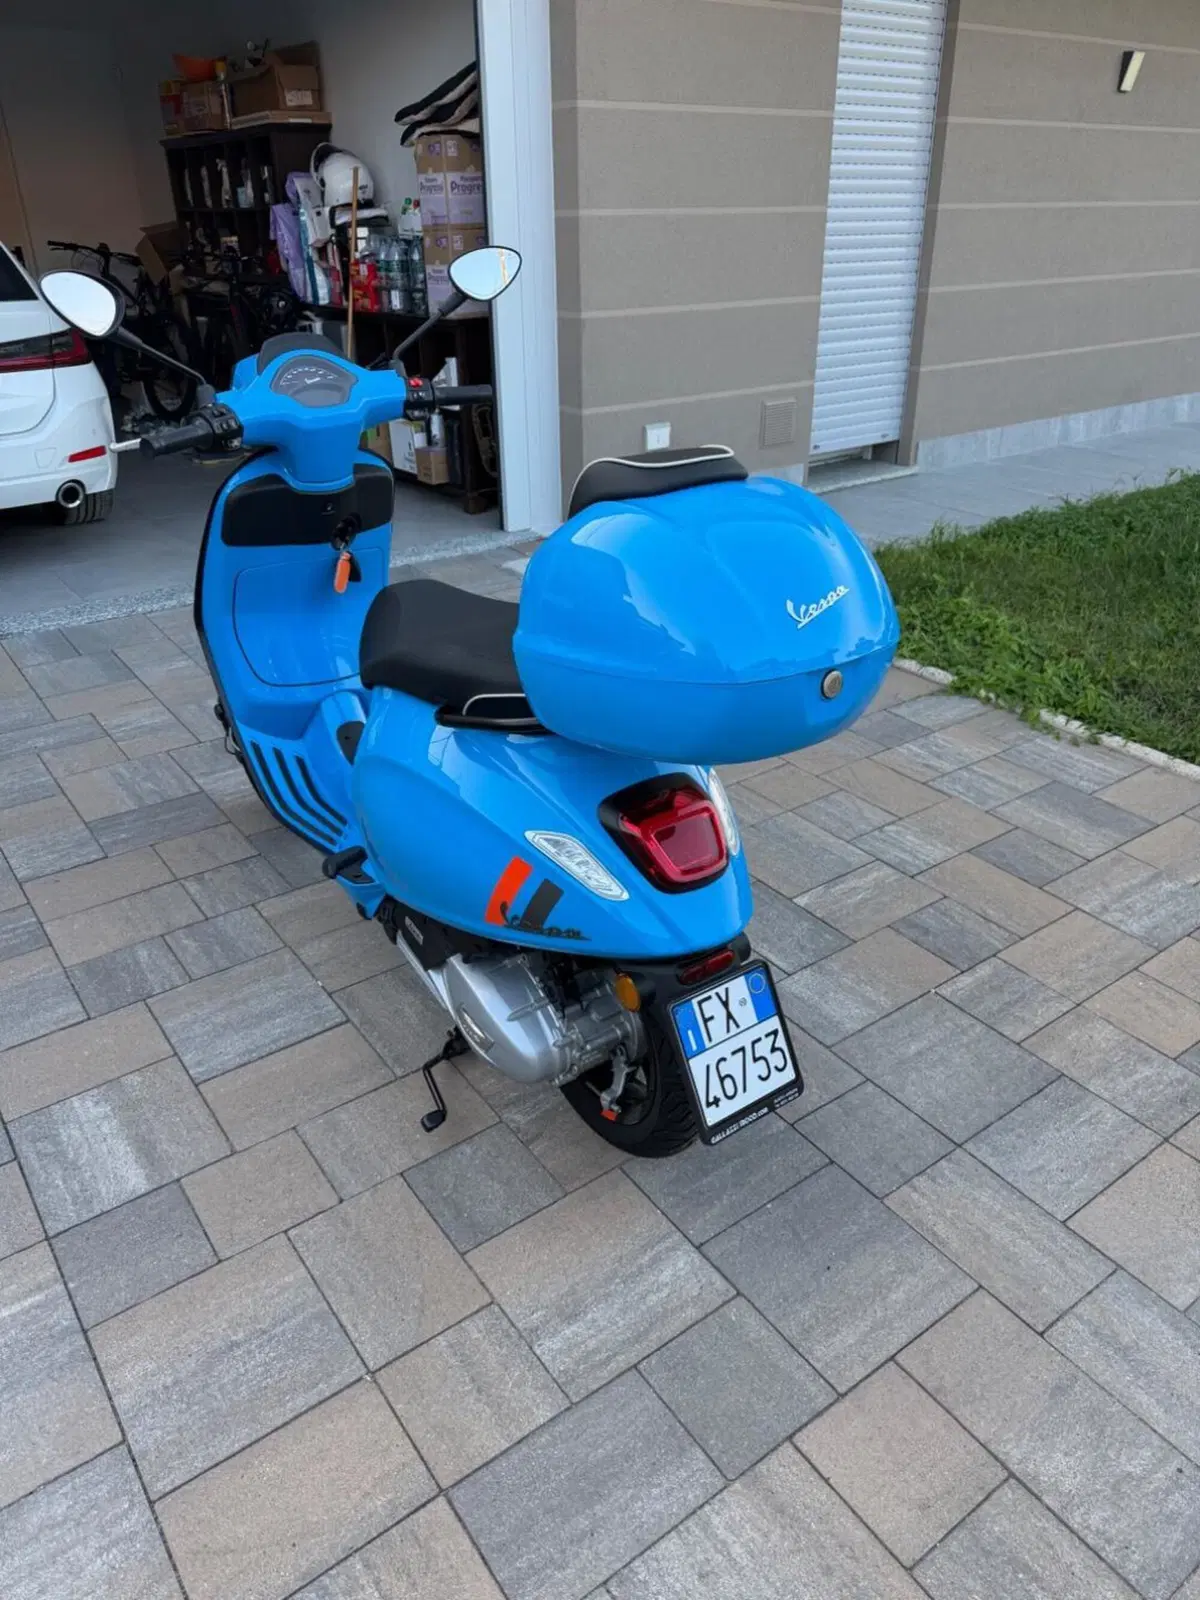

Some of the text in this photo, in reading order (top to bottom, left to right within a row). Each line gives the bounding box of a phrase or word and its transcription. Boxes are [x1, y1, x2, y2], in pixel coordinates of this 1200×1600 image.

[785, 584, 850, 630] Vespa
[696, 986, 741, 1043] FX
[705, 1028, 788, 1109] 46753
